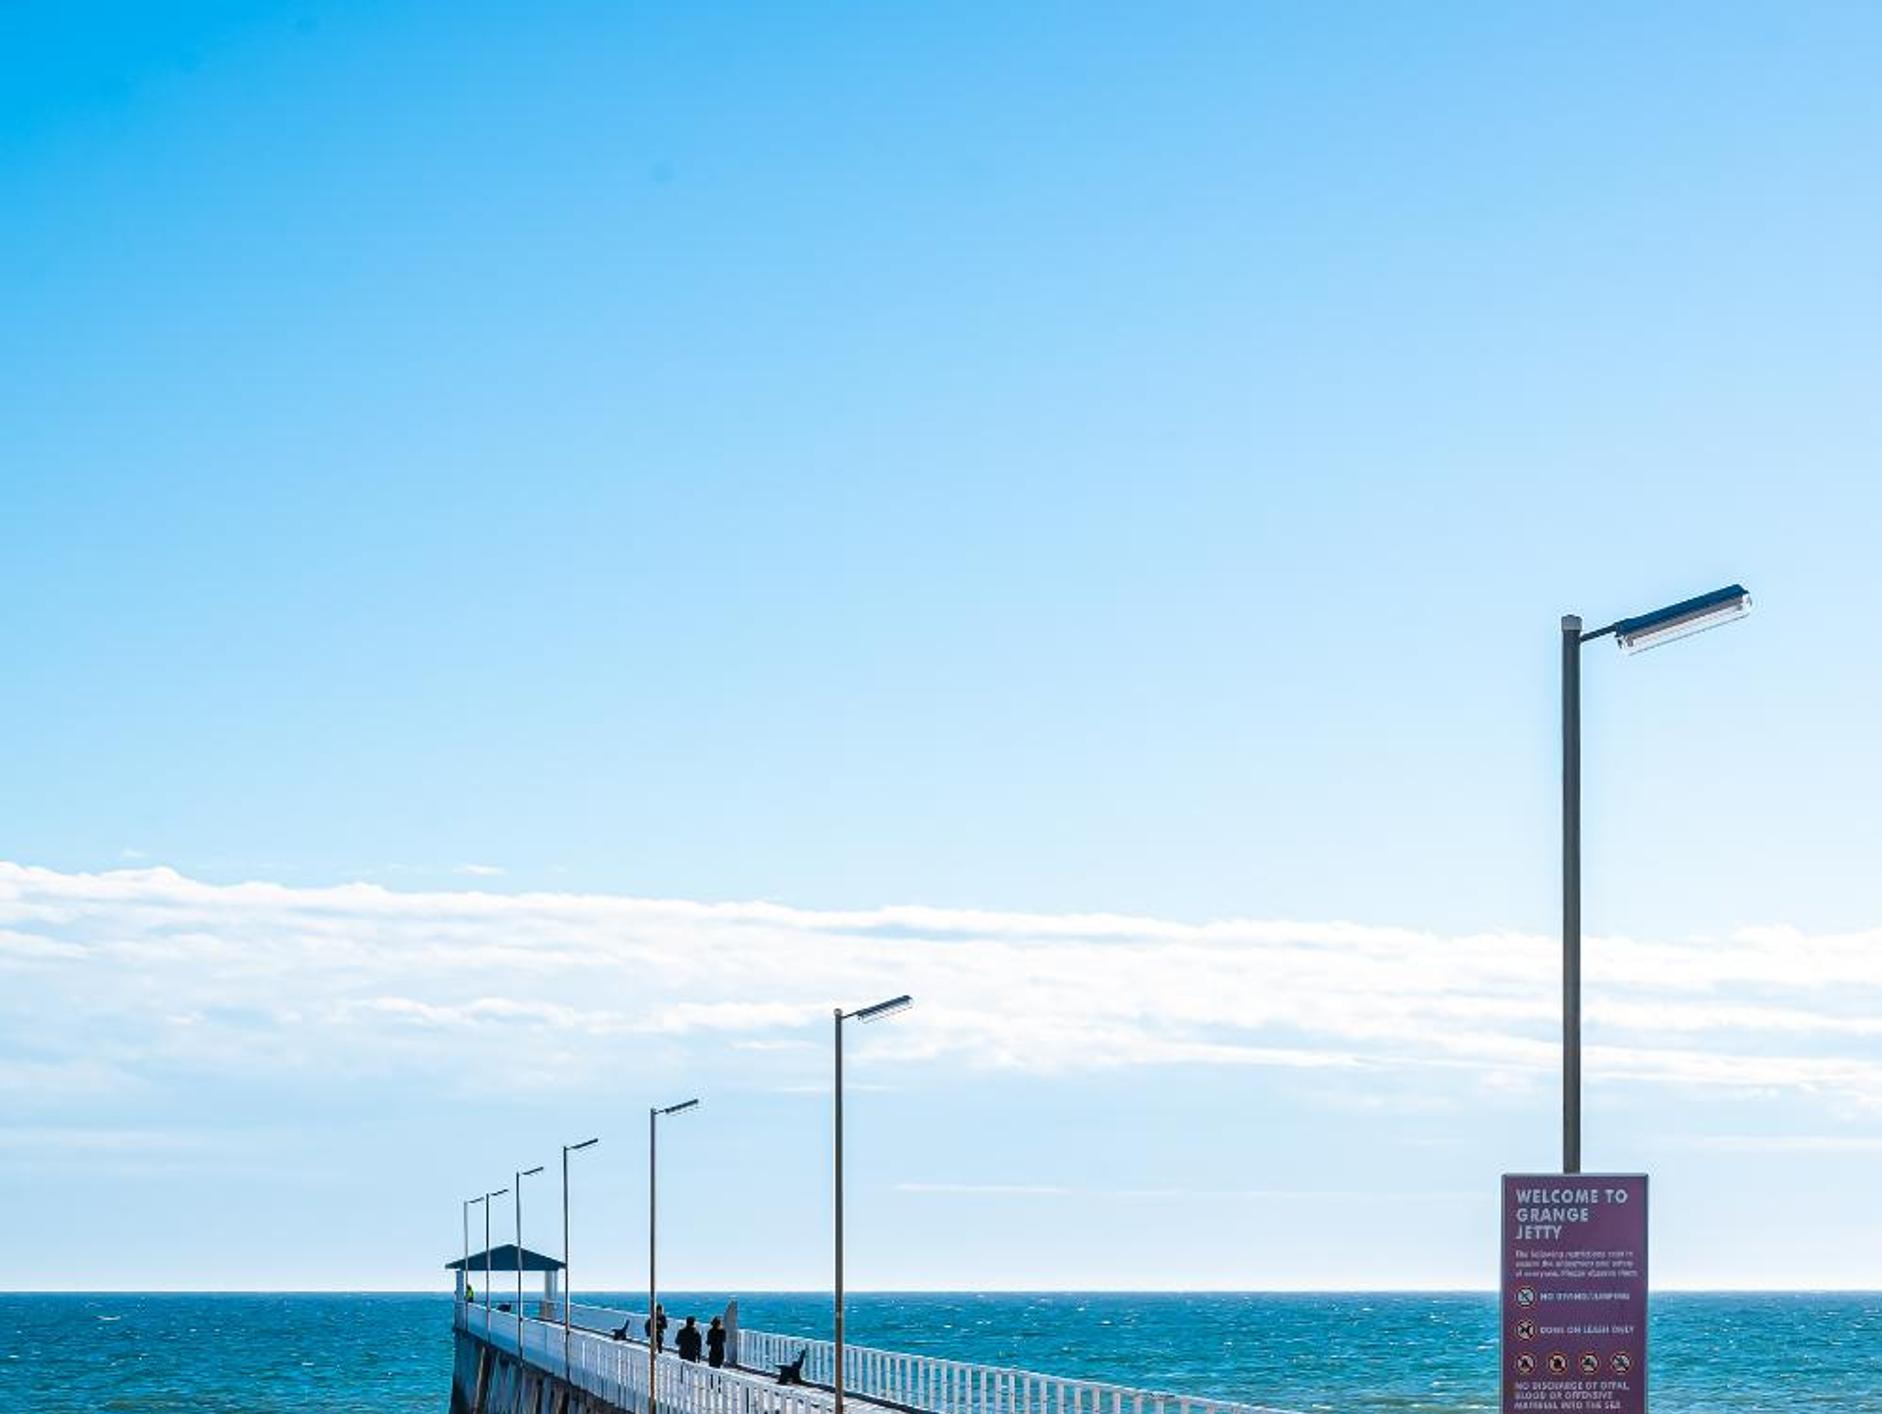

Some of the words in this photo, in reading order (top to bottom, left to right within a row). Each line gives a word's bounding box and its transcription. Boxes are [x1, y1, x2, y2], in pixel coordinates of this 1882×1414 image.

[1516, 1189, 1599, 1204] WELCOME
[1605, 1189, 1628, 1204] TO
[1516, 1208, 1589, 1222] GRANGE
[1516, 1225, 1562, 1240] JETTY
[1540, 1293, 1553, 1301] NO
[1566, 1326, 1581, 1334] ON
[1611, 1326, 1635, 1334] ONLY
[1514, 1382, 1529, 1390] NO
[1532, 1382, 1584, 1390] DISCHARGE
[1585, 1382, 1598, 1390] OF
[1515, 1391, 1545, 1399] BLOOD
[1549, 1391, 1563, 1399] OR
[1564, 1391, 1613, 1399] OFFENSIVE
[1514, 1401, 1558, 1409] MATERIAL
[1561, 1401, 1583, 1409] INTO
[1585, 1401, 1602, 1409] THE
